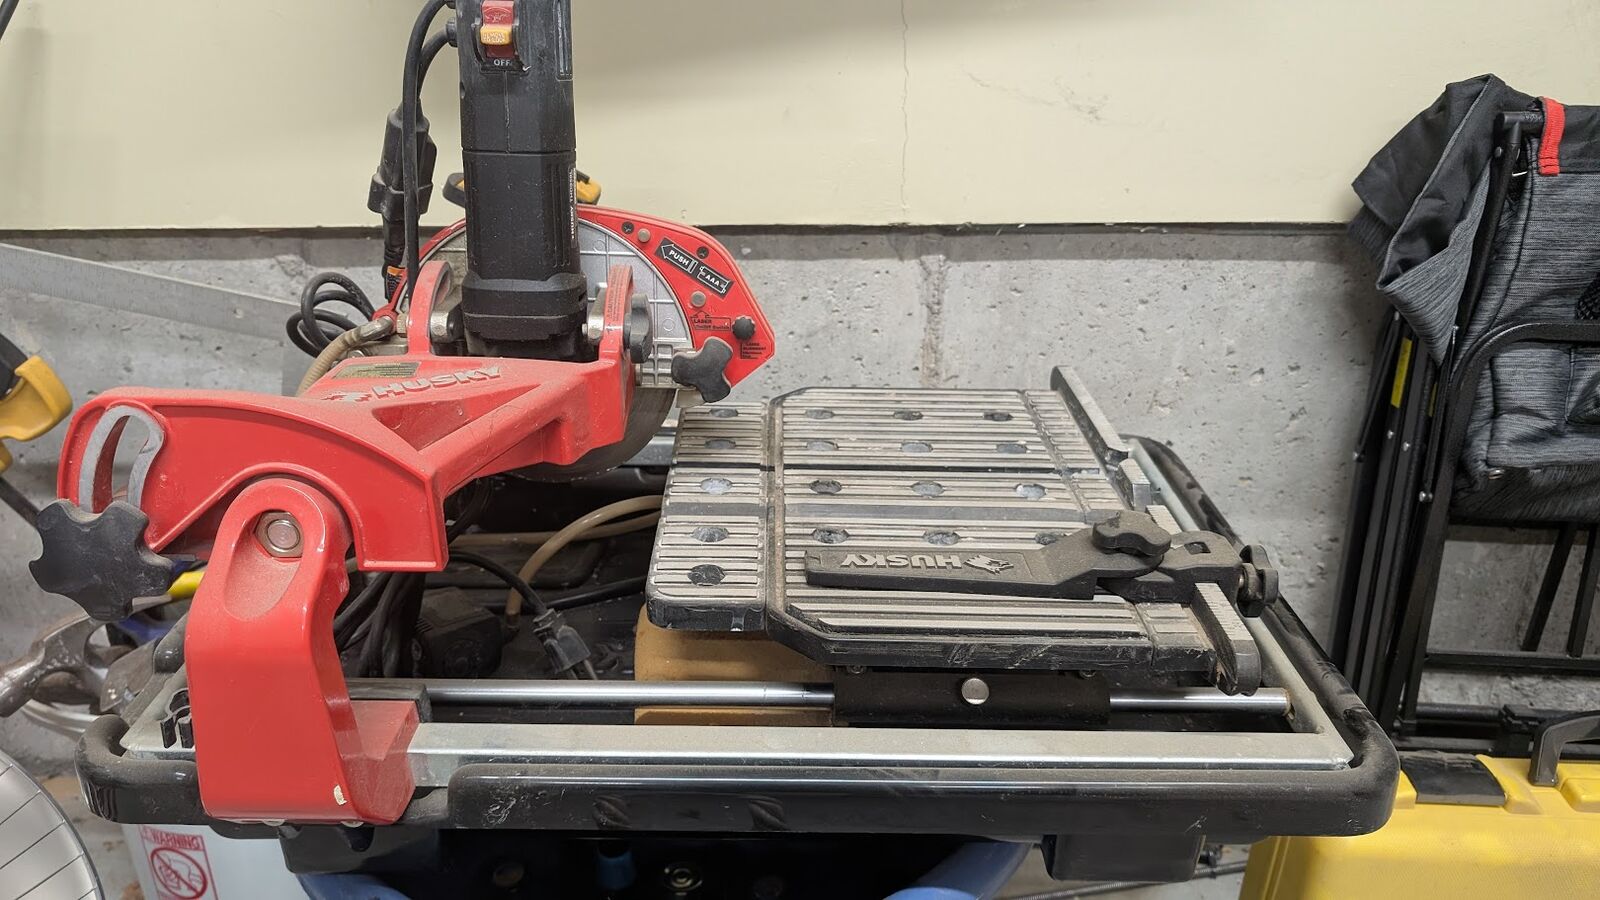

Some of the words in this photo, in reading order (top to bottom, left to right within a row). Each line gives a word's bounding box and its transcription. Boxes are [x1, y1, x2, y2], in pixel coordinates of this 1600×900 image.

[493, 58, 511, 66] OFF
[668, 249, 690, 266] PUSH
[372, 365, 501, 398] HUSKY
[840, 553, 963, 569] HUSKY
[150, 829, 201, 850] WARNING
